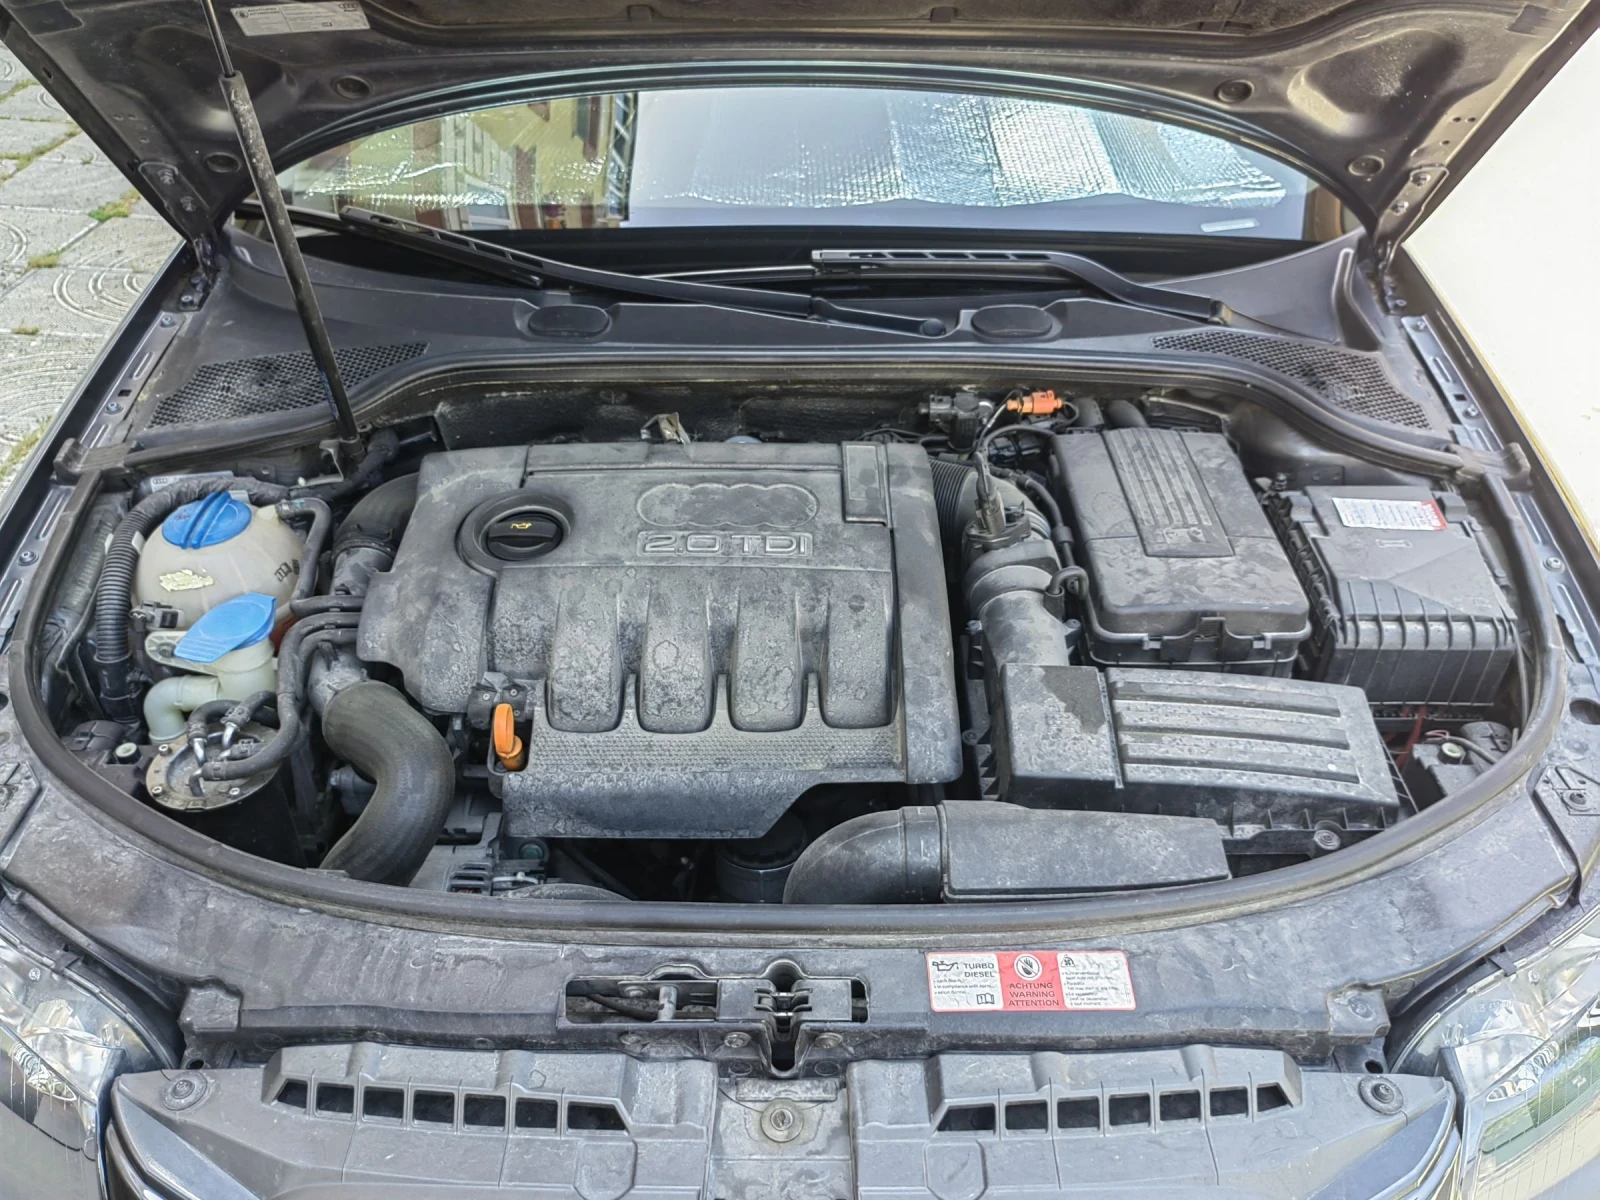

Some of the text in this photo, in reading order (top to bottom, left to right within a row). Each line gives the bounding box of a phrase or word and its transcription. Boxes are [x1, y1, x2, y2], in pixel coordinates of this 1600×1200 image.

[644, 534, 807, 555] 2.0 TDI
[963, 962, 995, 970] TURBO
[1009, 990, 1056, 998] WARNING
[1008, 999, 1060, 1007] ATTENTION
